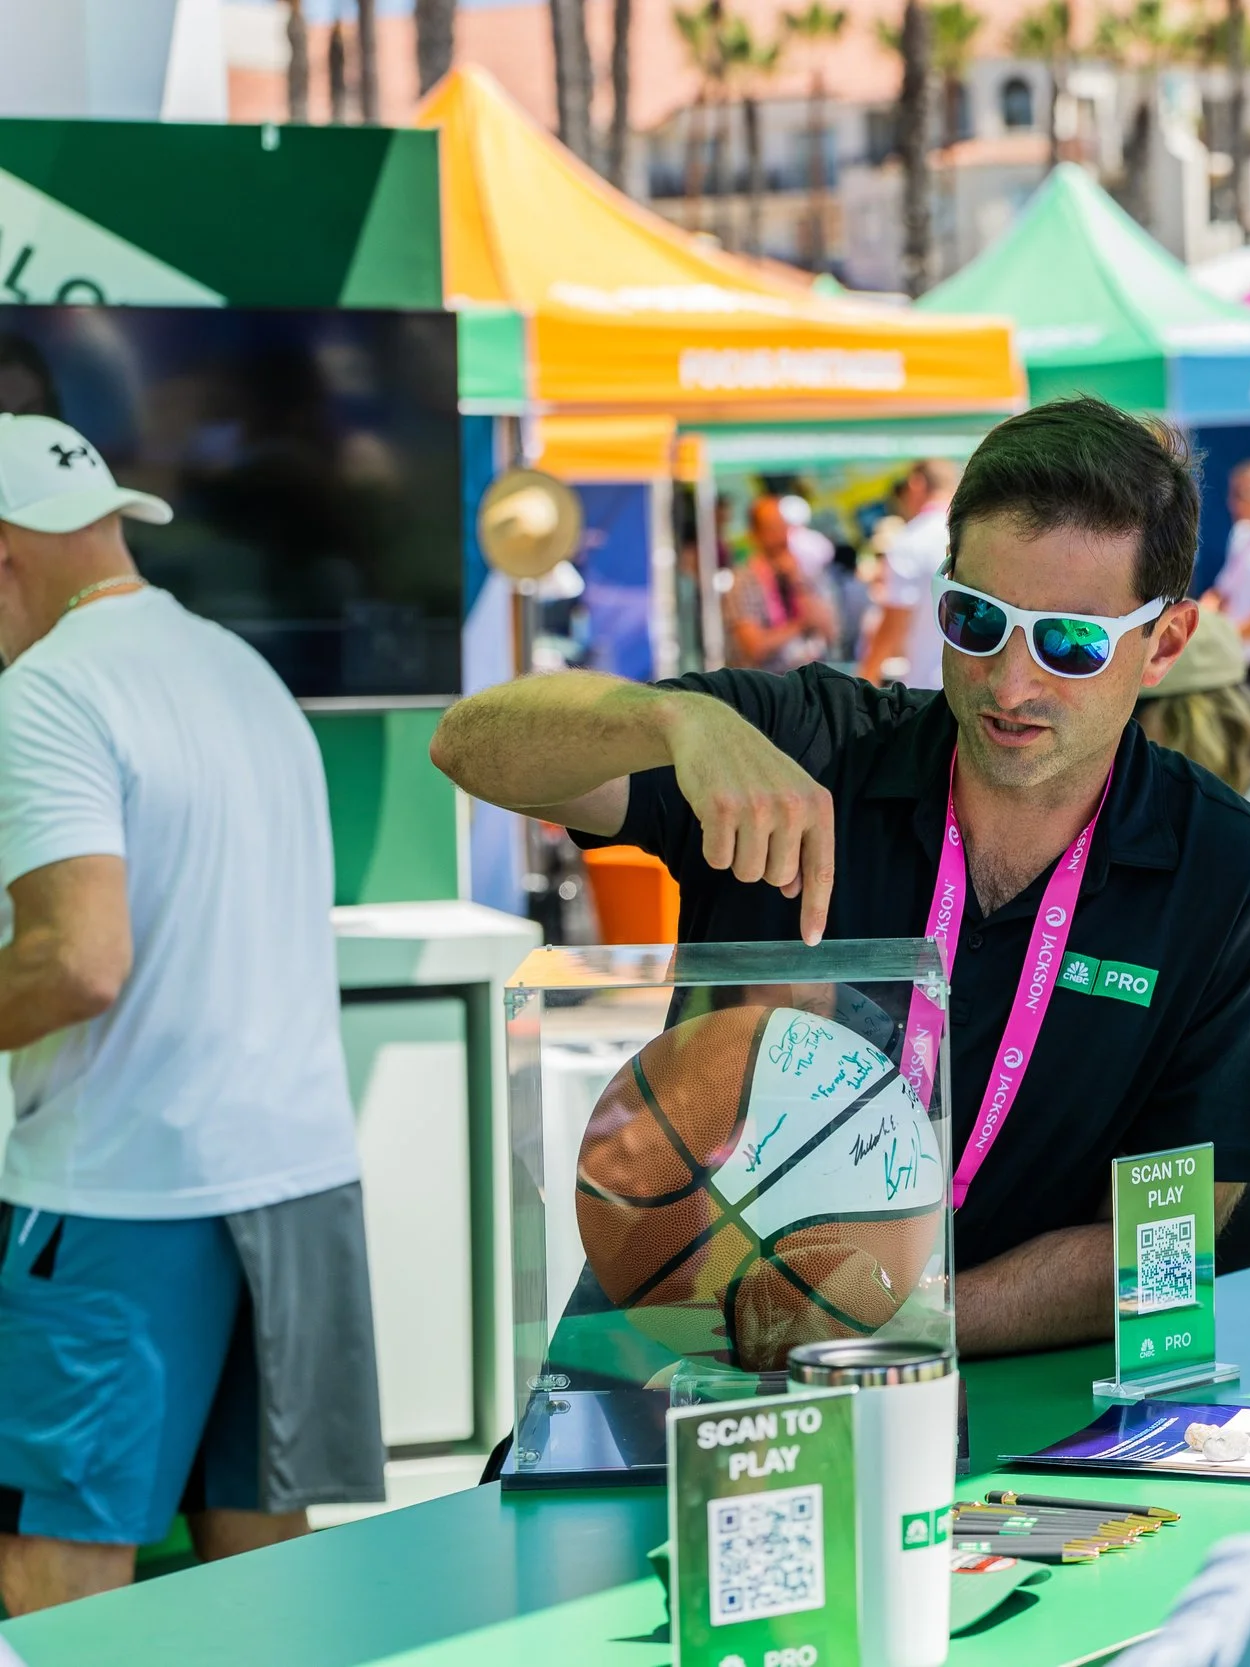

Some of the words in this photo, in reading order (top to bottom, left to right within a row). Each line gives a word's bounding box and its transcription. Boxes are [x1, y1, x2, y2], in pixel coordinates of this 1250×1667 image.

[933, 882, 956, 940] CKSON
[1025, 932, 1057, 1011] JACKSON
[1063, 972, 1089, 985] CNBC
[1105, 971, 1149, 994] PRO
[975, 1073, 1013, 1150] JACKSON
[1131, 1161, 1172, 1185] SCAN
[1175, 1157, 1196, 1177] TO
[1148, 1185, 1184, 1209] PLAY
[1165, 1332, 1191, 1351] PRO
[697, 1412, 778, 1450] SCAN
[781, 1406, 823, 1437] TO
[729, 1443, 801, 1481] PLAY
[763, 1644, 818, 1667] PRO
